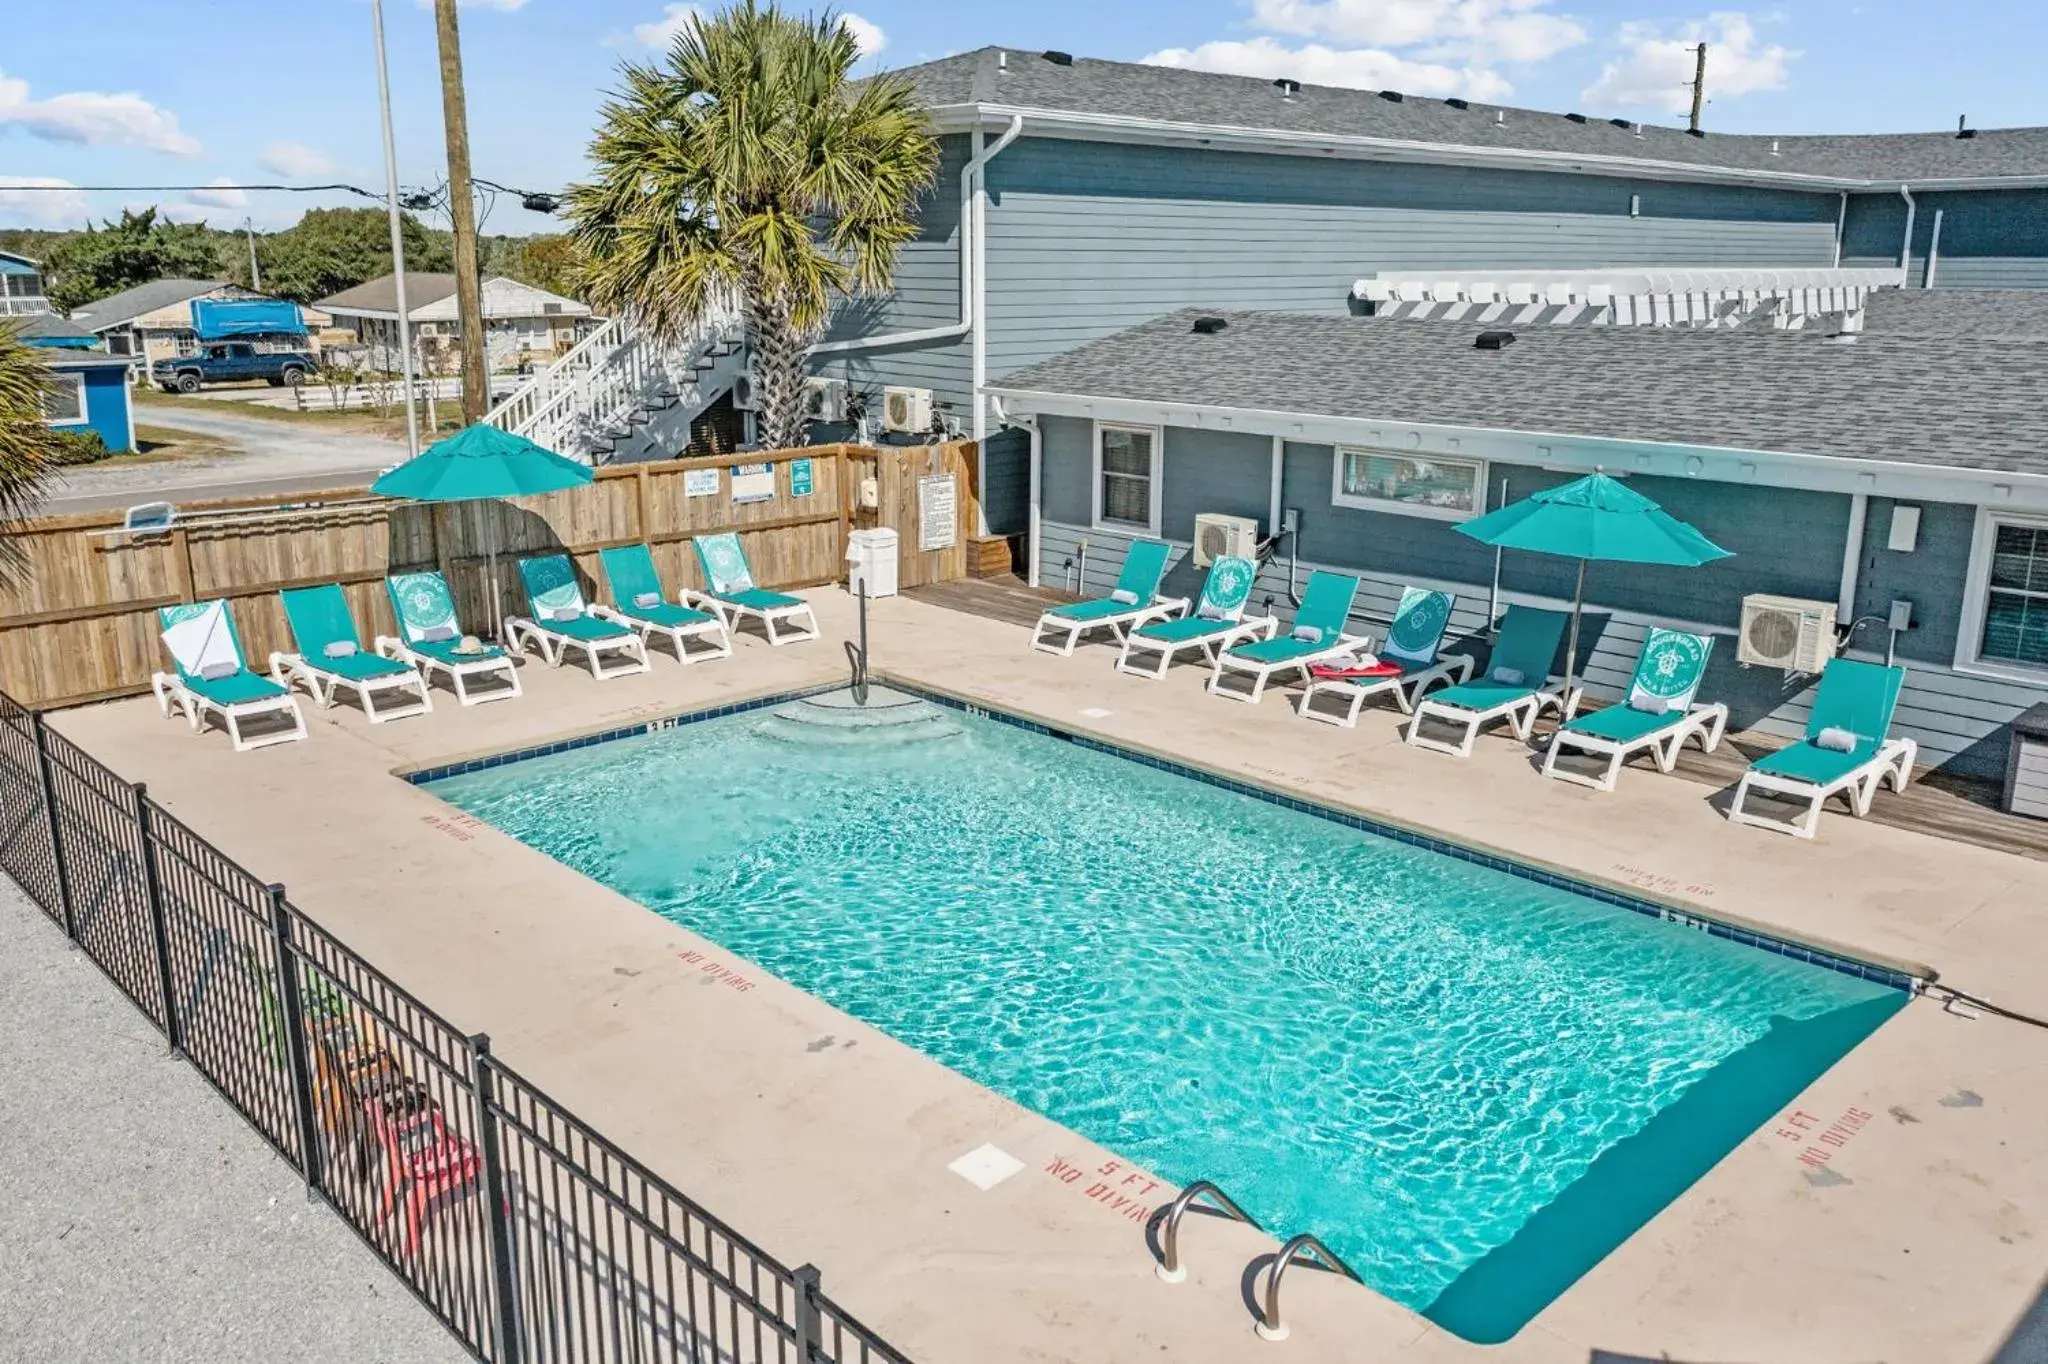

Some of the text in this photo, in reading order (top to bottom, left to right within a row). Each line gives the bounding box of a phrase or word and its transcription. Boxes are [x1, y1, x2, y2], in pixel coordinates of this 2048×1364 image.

[663, 718, 677, 729] FT
[677, 950, 756, 993] NO DIVING
[1776, 1110, 1821, 1142] 5 FT
[1796, 1107, 1875, 1169] NO DIVING
[1045, 1159, 1169, 1228] NO DIVIN
[1097, 1160, 1160, 1196] 5 FT
